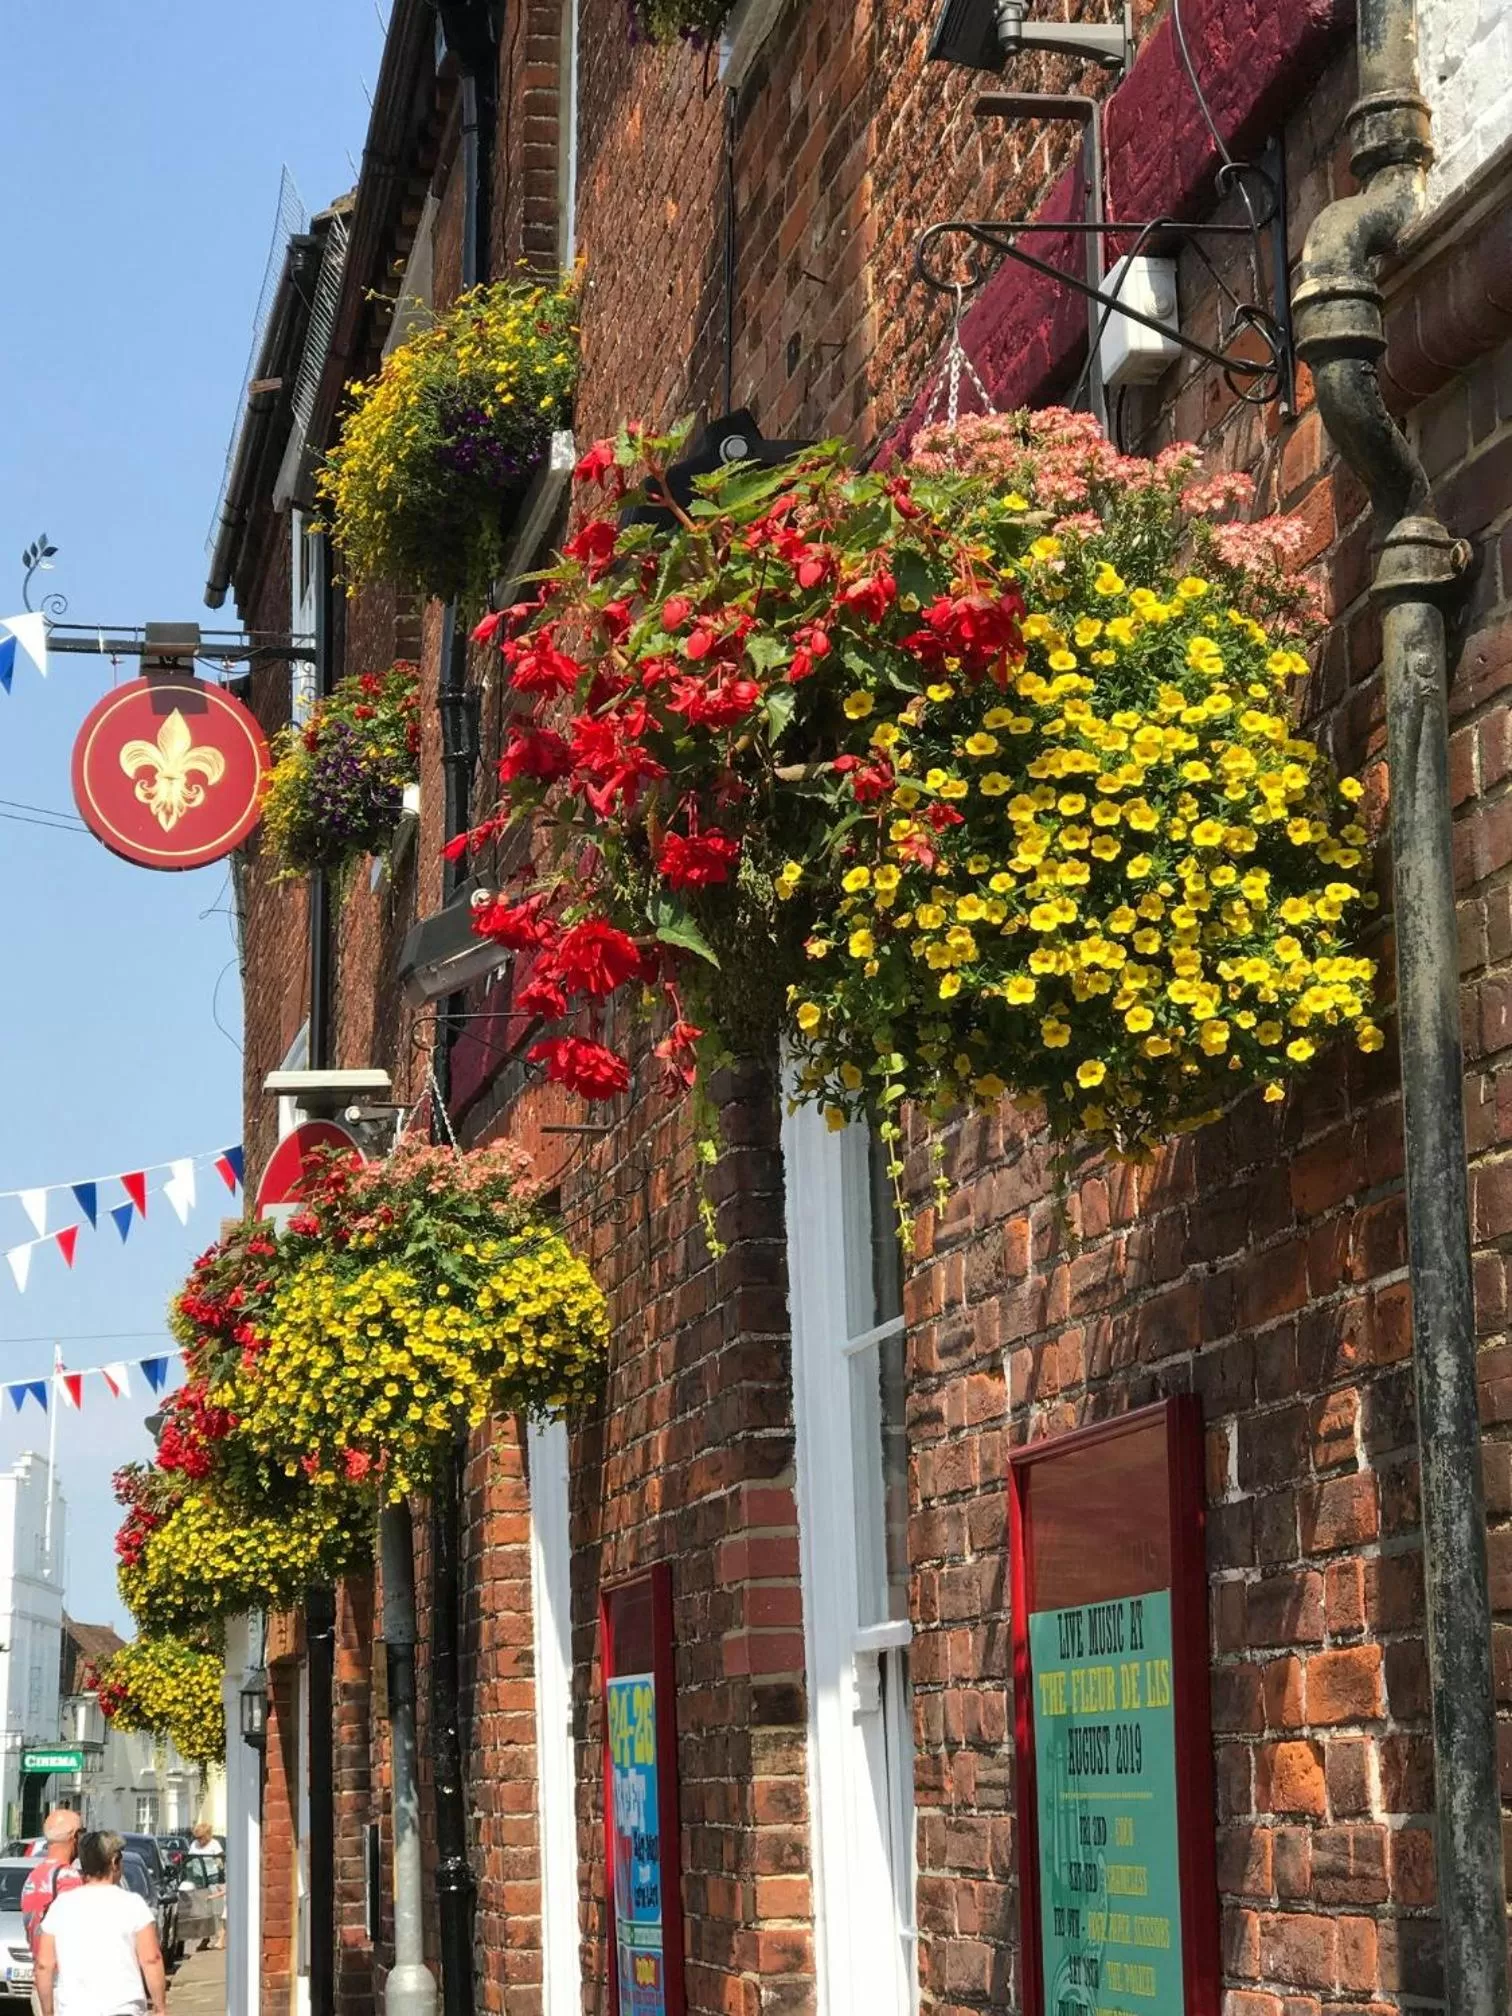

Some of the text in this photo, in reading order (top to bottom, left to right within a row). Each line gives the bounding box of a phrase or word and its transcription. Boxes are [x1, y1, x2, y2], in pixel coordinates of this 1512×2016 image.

[1057, 1600, 1144, 1660] LIVE MUSIC AT
[1039, 1659, 1170, 1716] THE FLEUR DE LIS
[25, 1754, 78, 1768] CINEMA
[1068, 1722, 1142, 1776] AUGUST 2019
